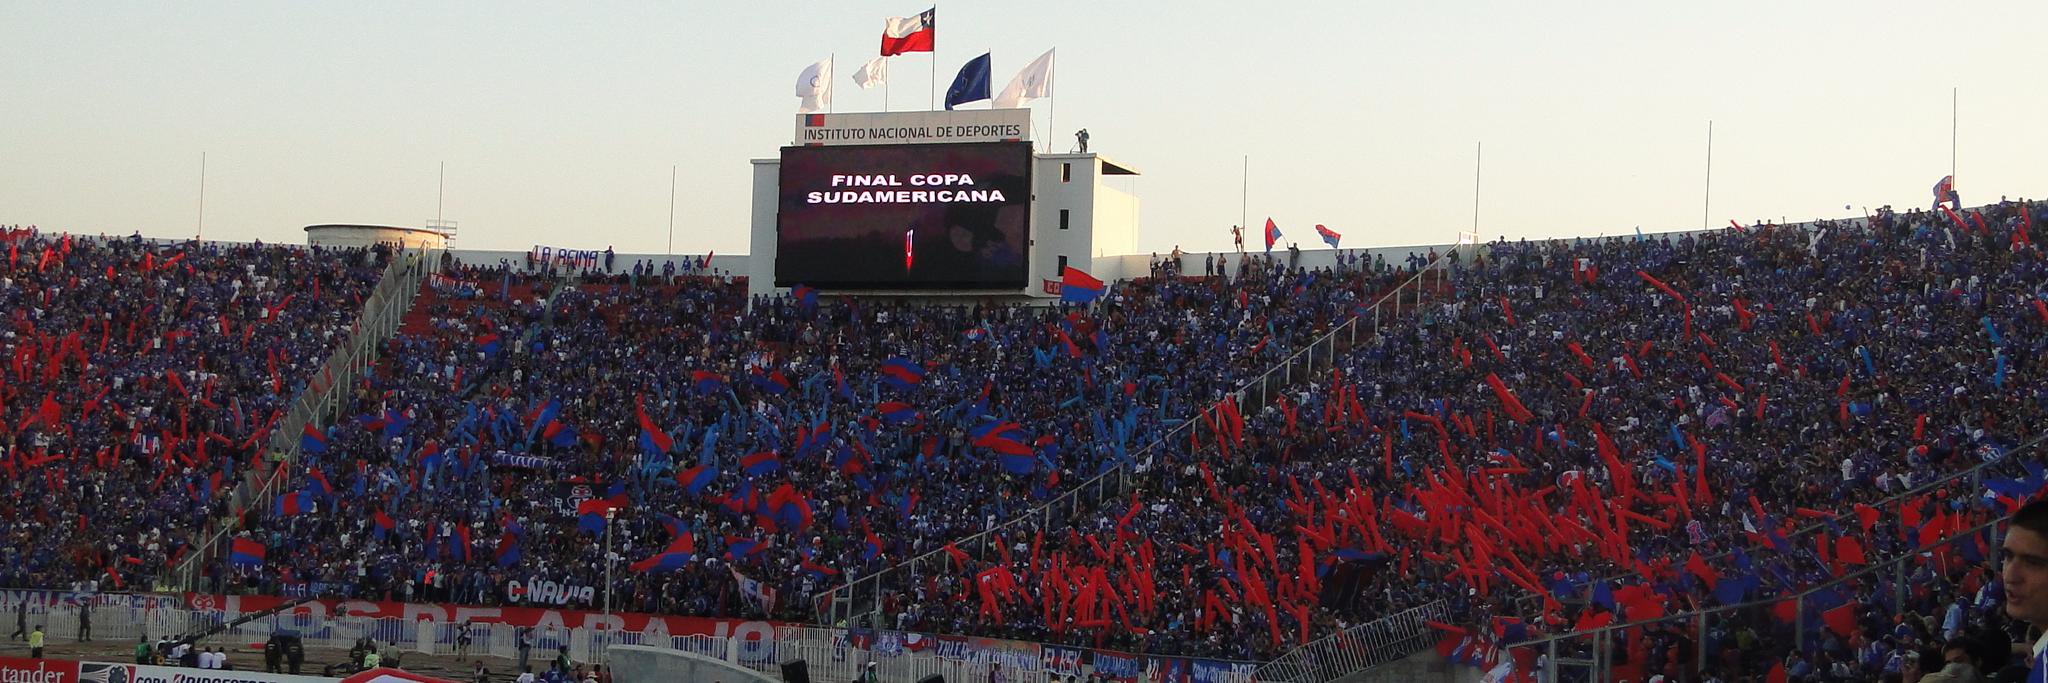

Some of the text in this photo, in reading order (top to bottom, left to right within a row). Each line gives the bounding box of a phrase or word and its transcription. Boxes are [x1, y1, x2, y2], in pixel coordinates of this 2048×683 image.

[804, 124, 1020, 140] INSTITUTO NACIONAL DE DEPORTES
[831, 174, 975, 187] FINAL COPA
[807, 190, 1006, 204] SUDAMERICANA
[173, 674, 277, 683] BRIDGE
